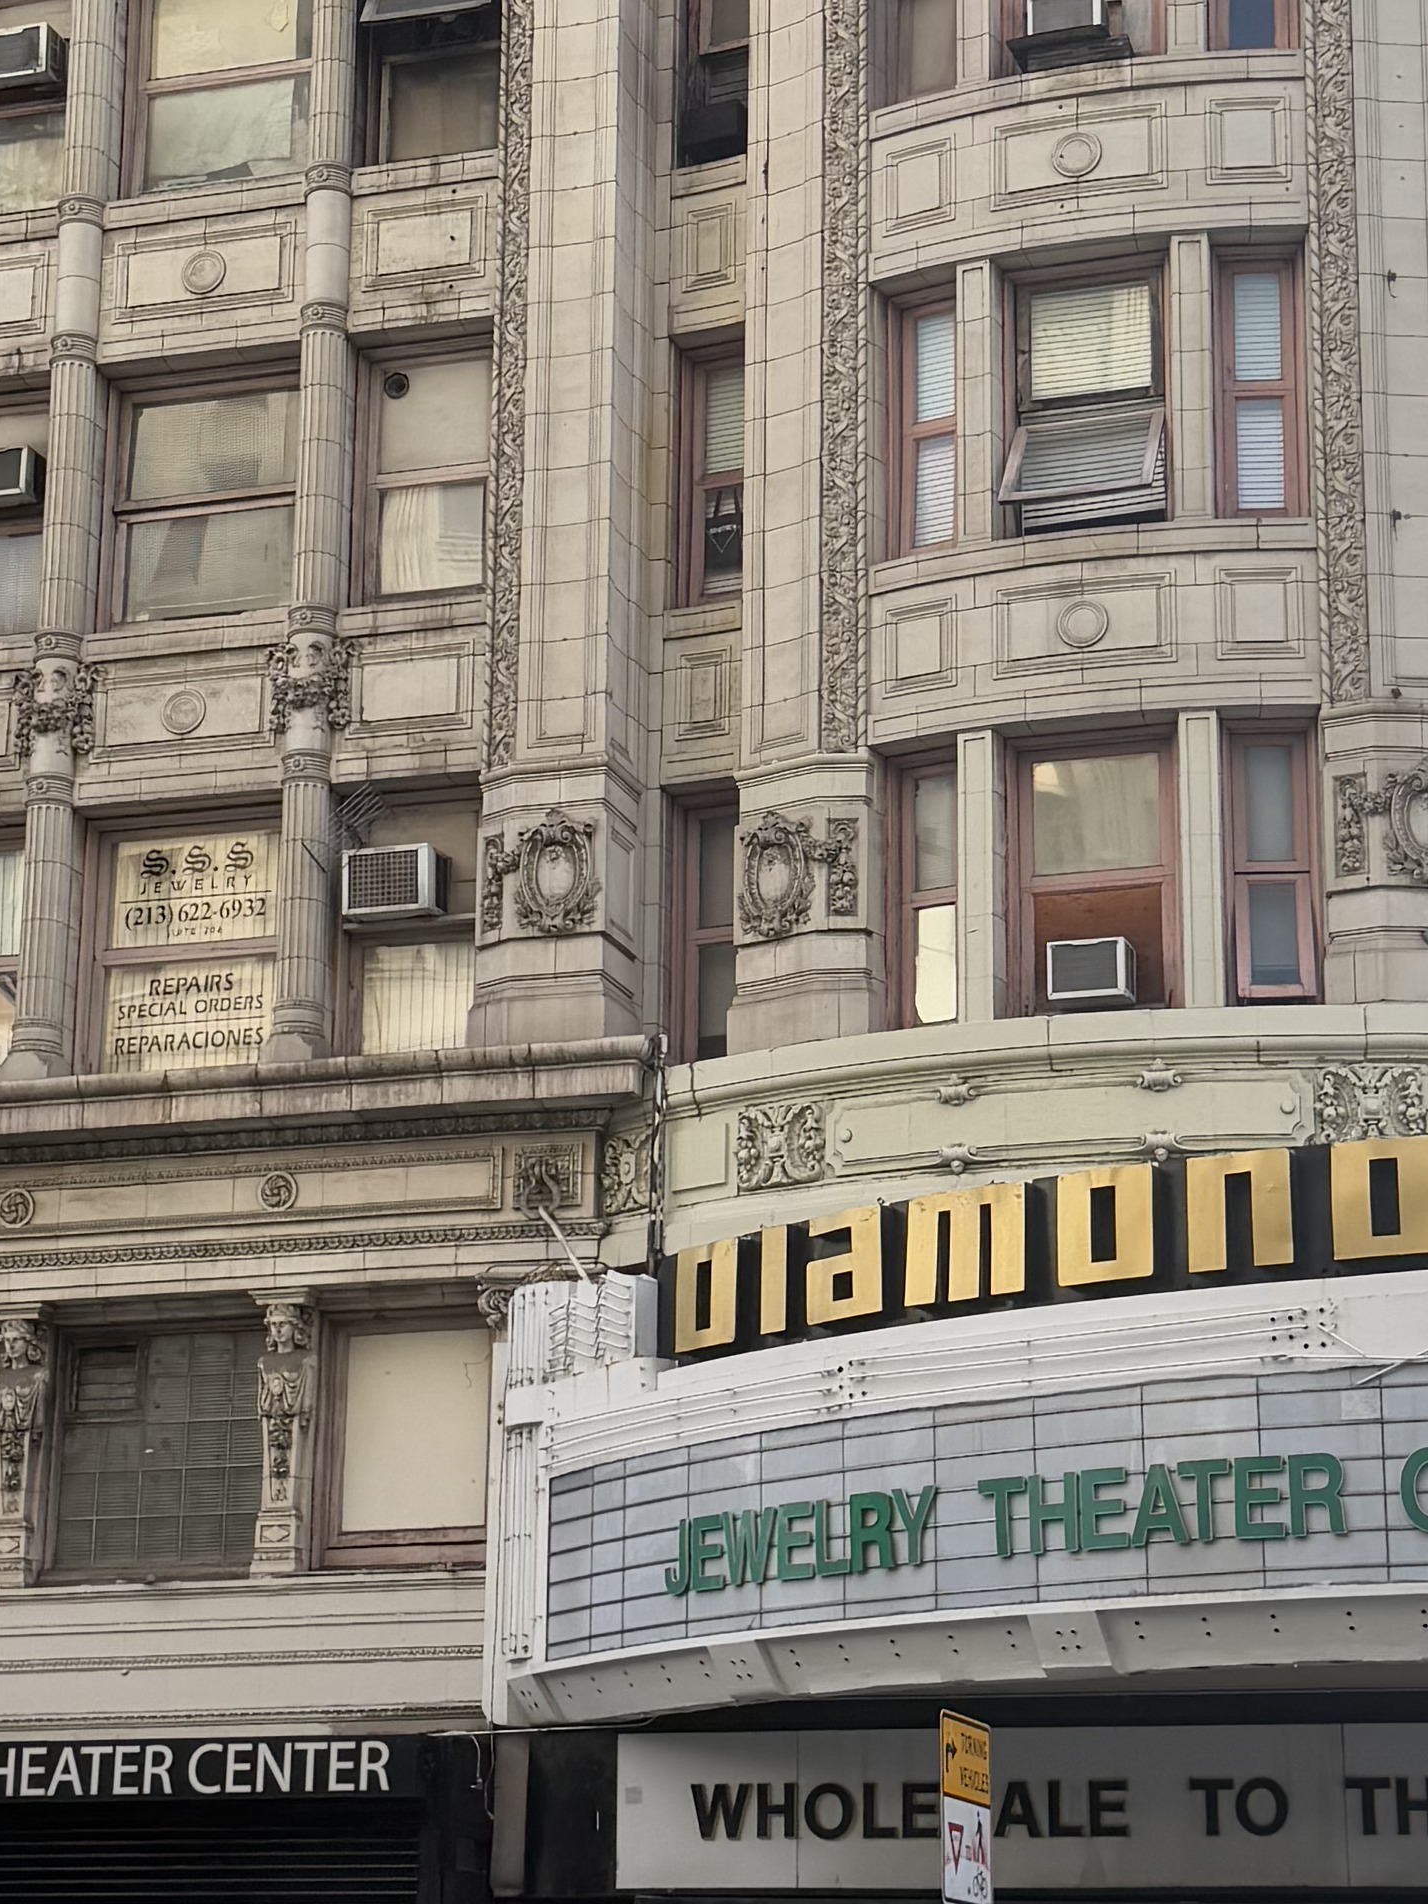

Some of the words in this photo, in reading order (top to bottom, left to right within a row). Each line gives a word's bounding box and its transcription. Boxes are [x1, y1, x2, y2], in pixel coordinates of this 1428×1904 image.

[141, 874, 251, 895] JEWELRY
[125, 903, 172, 931] (213)
[178, 897, 266, 922] 622-6932
[149, 973, 234, 997] REPAIRS
[118, 1000, 187, 1021] SPECIAL
[195, 994, 263, 1014] ORDERS
[114, 1027, 264, 1056] REPARACIONES
[664, 1485, 938, 1596] JEWELRY
[976, 1450, 1349, 1558] THEATER
[187, 1741, 390, 1794] CENTER
[690, 1777, 1129, 1840] WHOLEALE
[1188, 1776, 1291, 1838] TO
